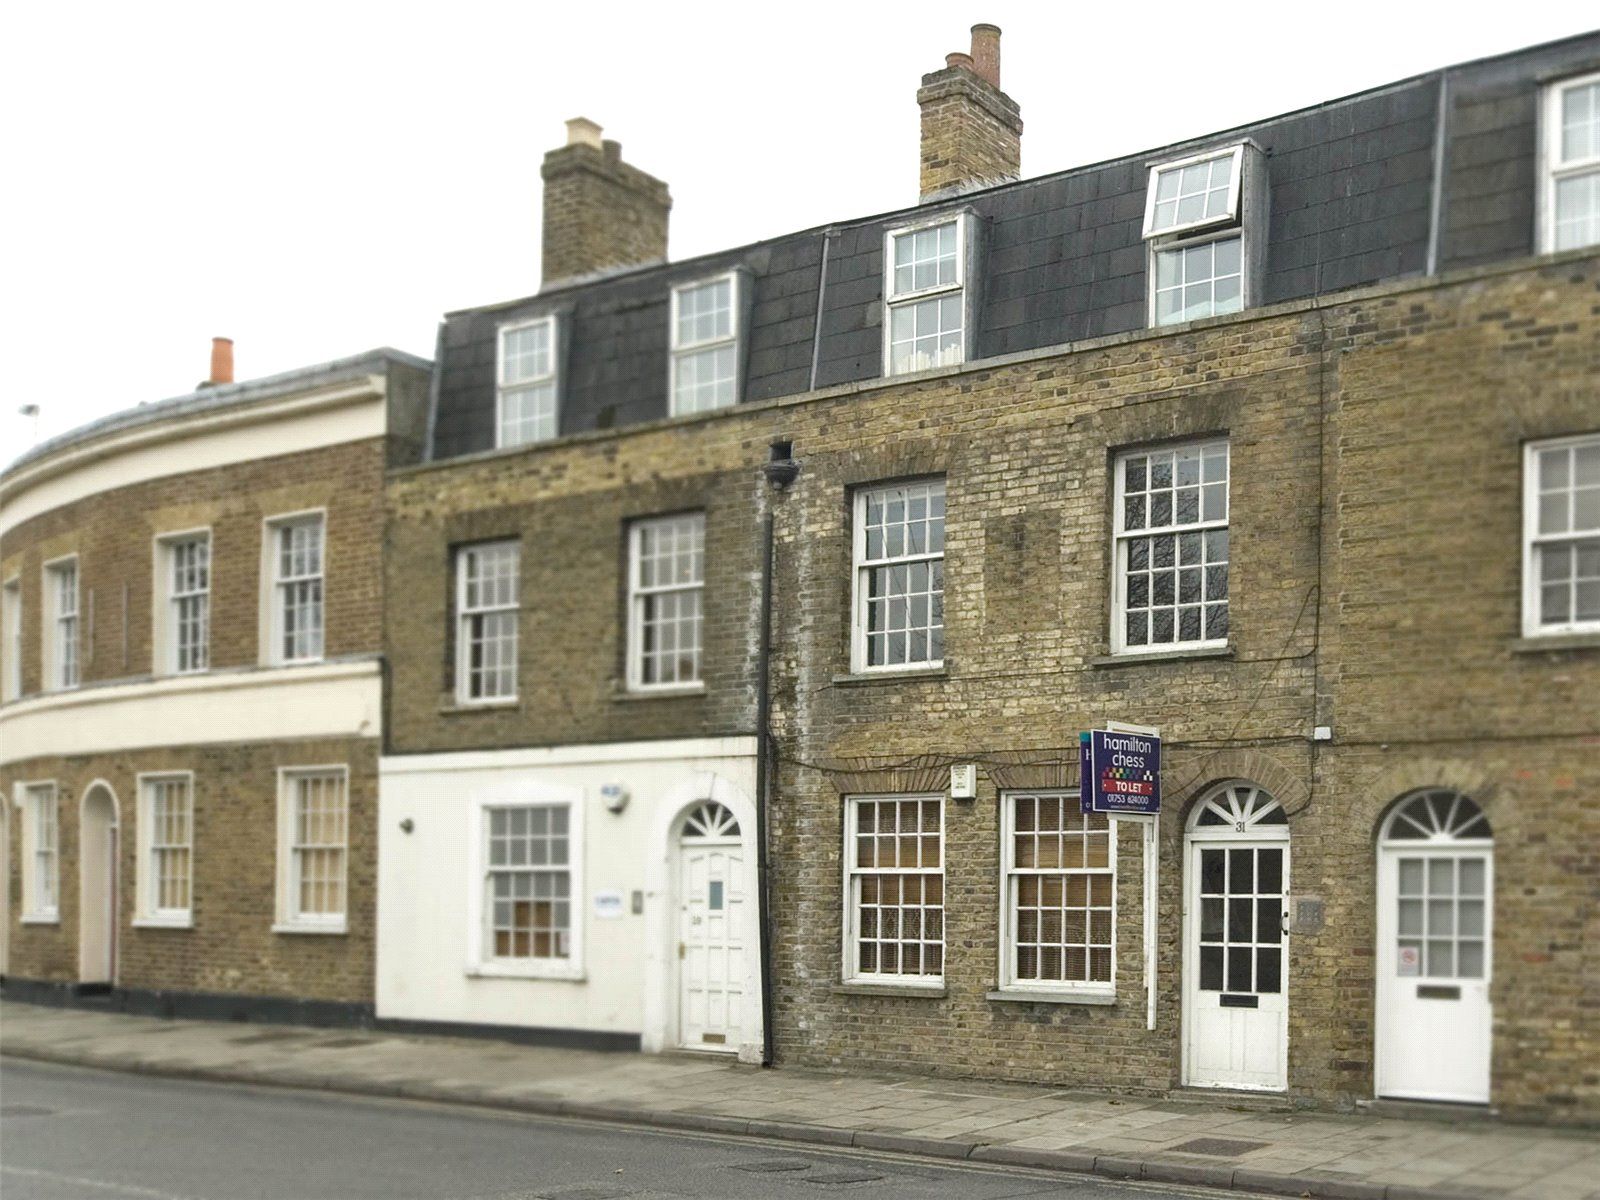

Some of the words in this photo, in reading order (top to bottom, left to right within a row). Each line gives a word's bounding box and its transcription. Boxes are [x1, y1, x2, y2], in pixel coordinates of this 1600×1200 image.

[1103, 733, 1152, 753] hamilton
[1112, 751, 1144, 768] chess
[1115, 781, 1127, 792] TO
[1128, 783, 1142, 793] LET
[1107, 794, 1126, 803] 01753
[1235, 821, 1246, 833] 31
